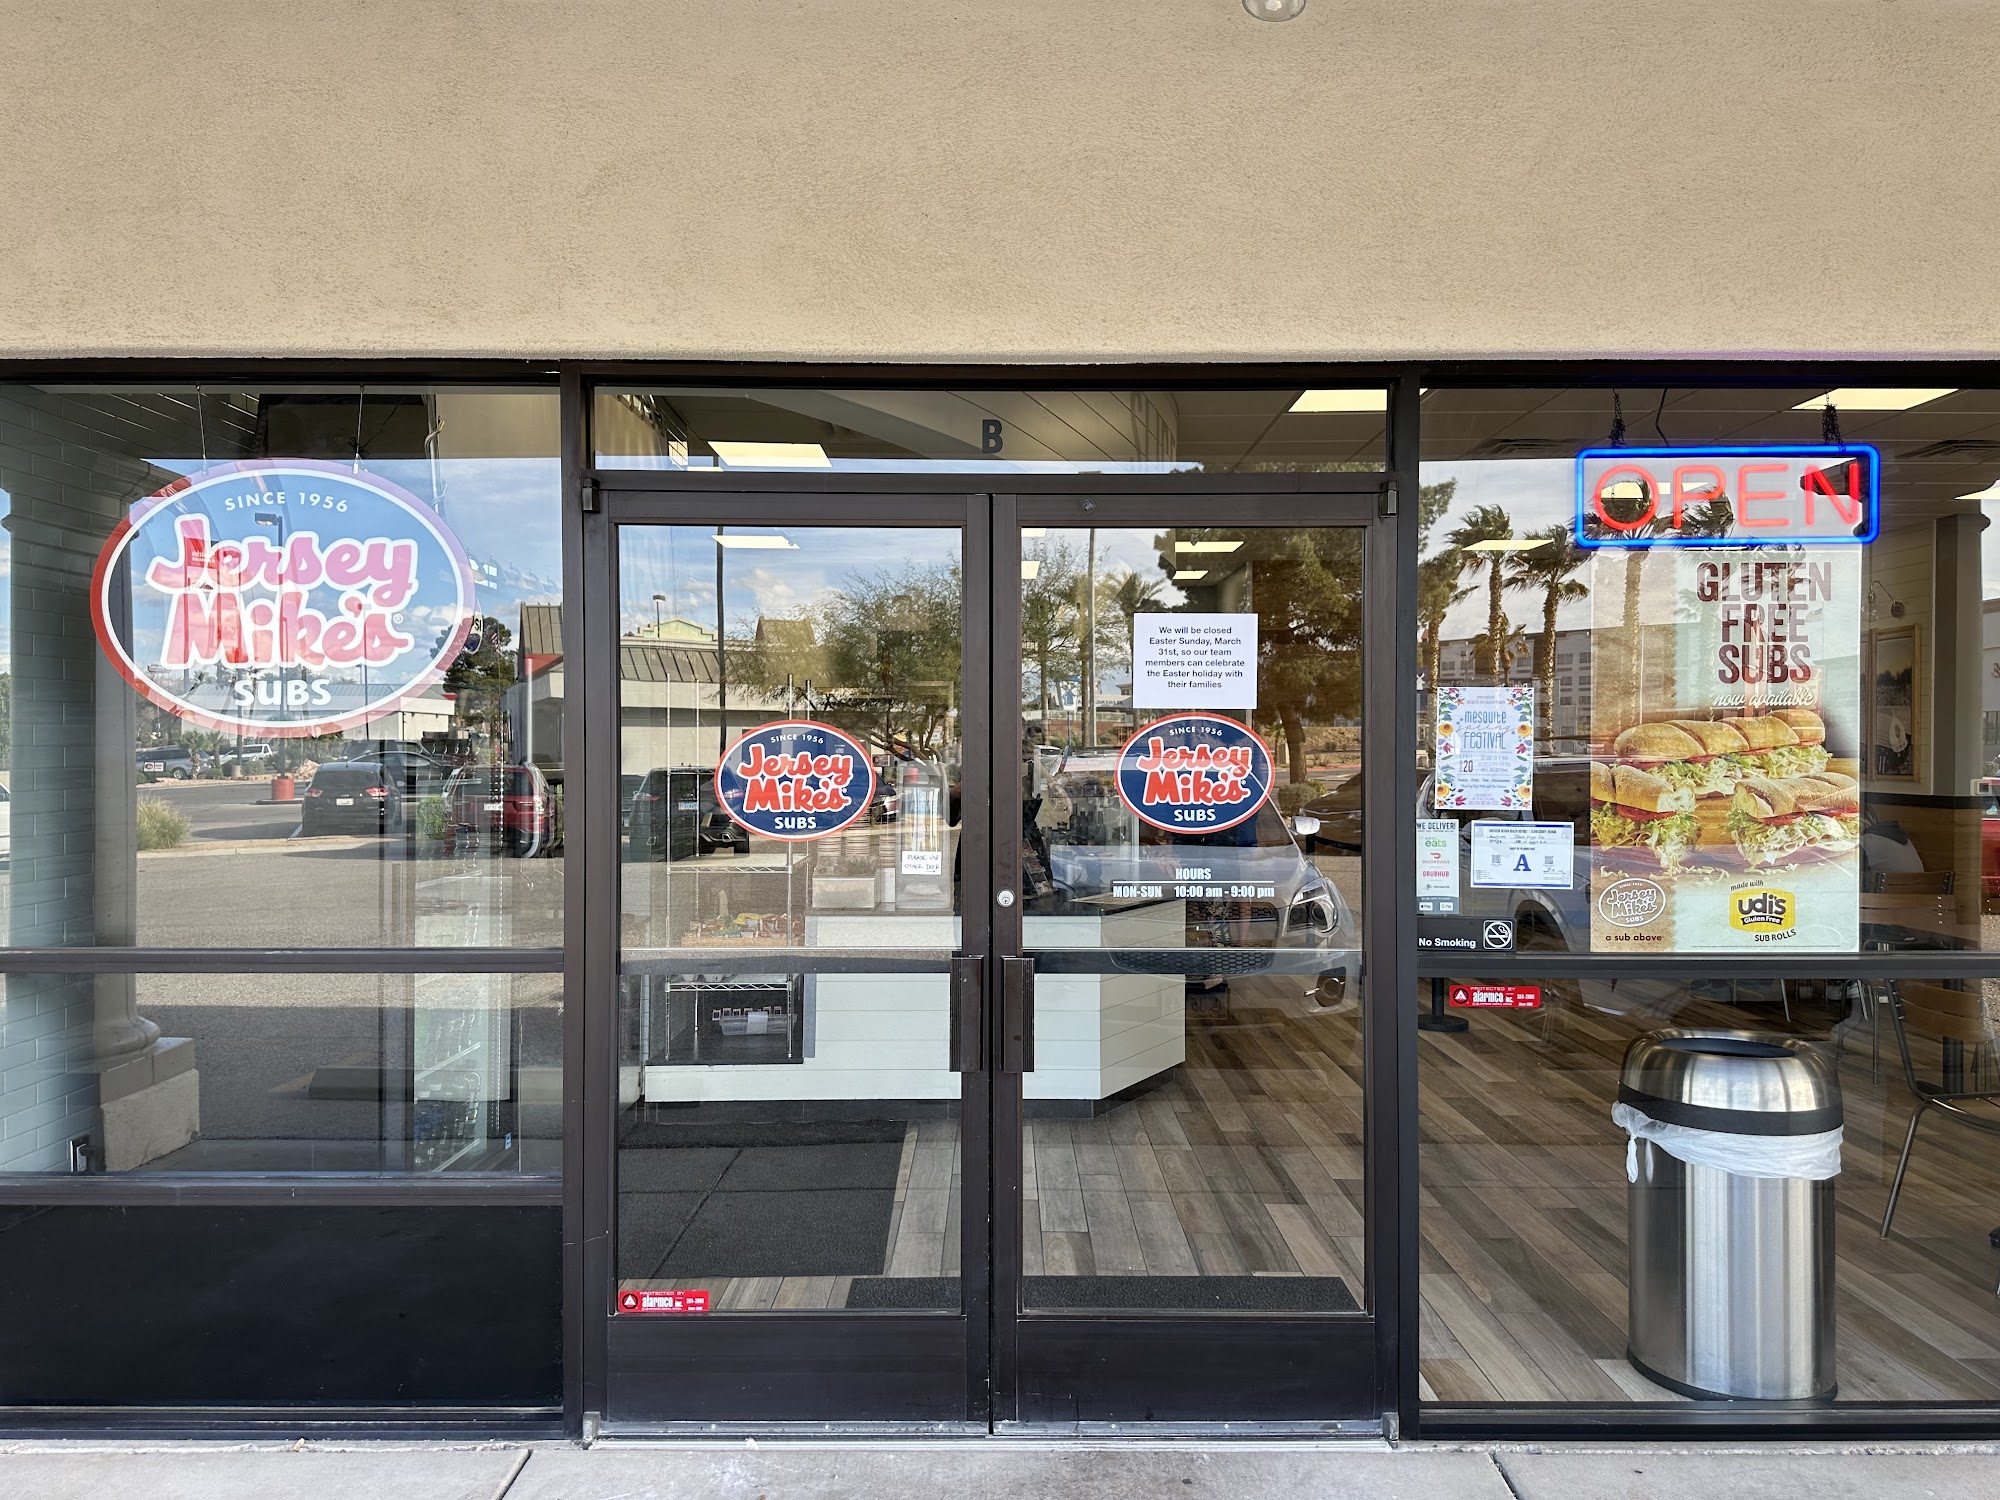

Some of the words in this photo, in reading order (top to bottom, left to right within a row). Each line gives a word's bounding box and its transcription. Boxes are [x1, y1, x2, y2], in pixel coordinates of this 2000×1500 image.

[982, 419, 1004, 454] B
[224, 491, 286, 511] SINCE
[299, 492, 348, 513] 1956
[1593, 462, 1861, 531] OPEN
[148, 516, 416, 610] Jersey
[1696, 562, 1832, 602] GLUTEN
[163, 589, 411, 667] Mike's
[1722, 604, 1808, 642] FREE
[1179, 638, 1212, 646] Sunday,
[1718, 644, 1811, 684] SUBS
[1192, 670, 1222, 678] holiday
[234, 679, 332, 706] SUBS
[1712, 694, 1745, 706] now
[1748, 687, 1814, 708] available
[1170, 726, 1196, 736] SINCE
[1201, 727, 1223, 736] 1956
[770, 734, 797, 743] SINCE
[802, 734, 824, 744] 1956
[738, 744, 852, 786] Jersey
[1138, 738, 1251, 778] Jersey
[1463, 760, 1473, 772] 20
[1144, 770, 1249, 804] Mike's
[744, 778, 850, 812] Mike's
[1174, 809, 1216, 822] SUBS
[774, 817, 817, 830] SUBS
[1425, 839, 1447, 847] eats
[1513, 854, 1531, 871] A
[1176, 868, 1211, 880] HOURS
[1113, 886, 1162, 898] MON-SUN
[1174, 886, 1203, 897] 10:00
[1206, 888, 1222, 897] am
[1231, 886, 1255, 897] 9:00
[1257, 888, 1274, 899] pm
[1730, 881, 1748, 891] made
[1608, 889, 1656, 904] Jersey
[1738, 893, 1786, 915] udi's
[1634, 933, 1662, 941] above
[1772, 929, 1796, 940] ROLLS
[1418, 938, 1432, 946] No
[1434, 938, 1476, 948] Smoking
[1473, 990, 1504, 1002] alarmco
[642, 1295, 673, 1308] alarmco
